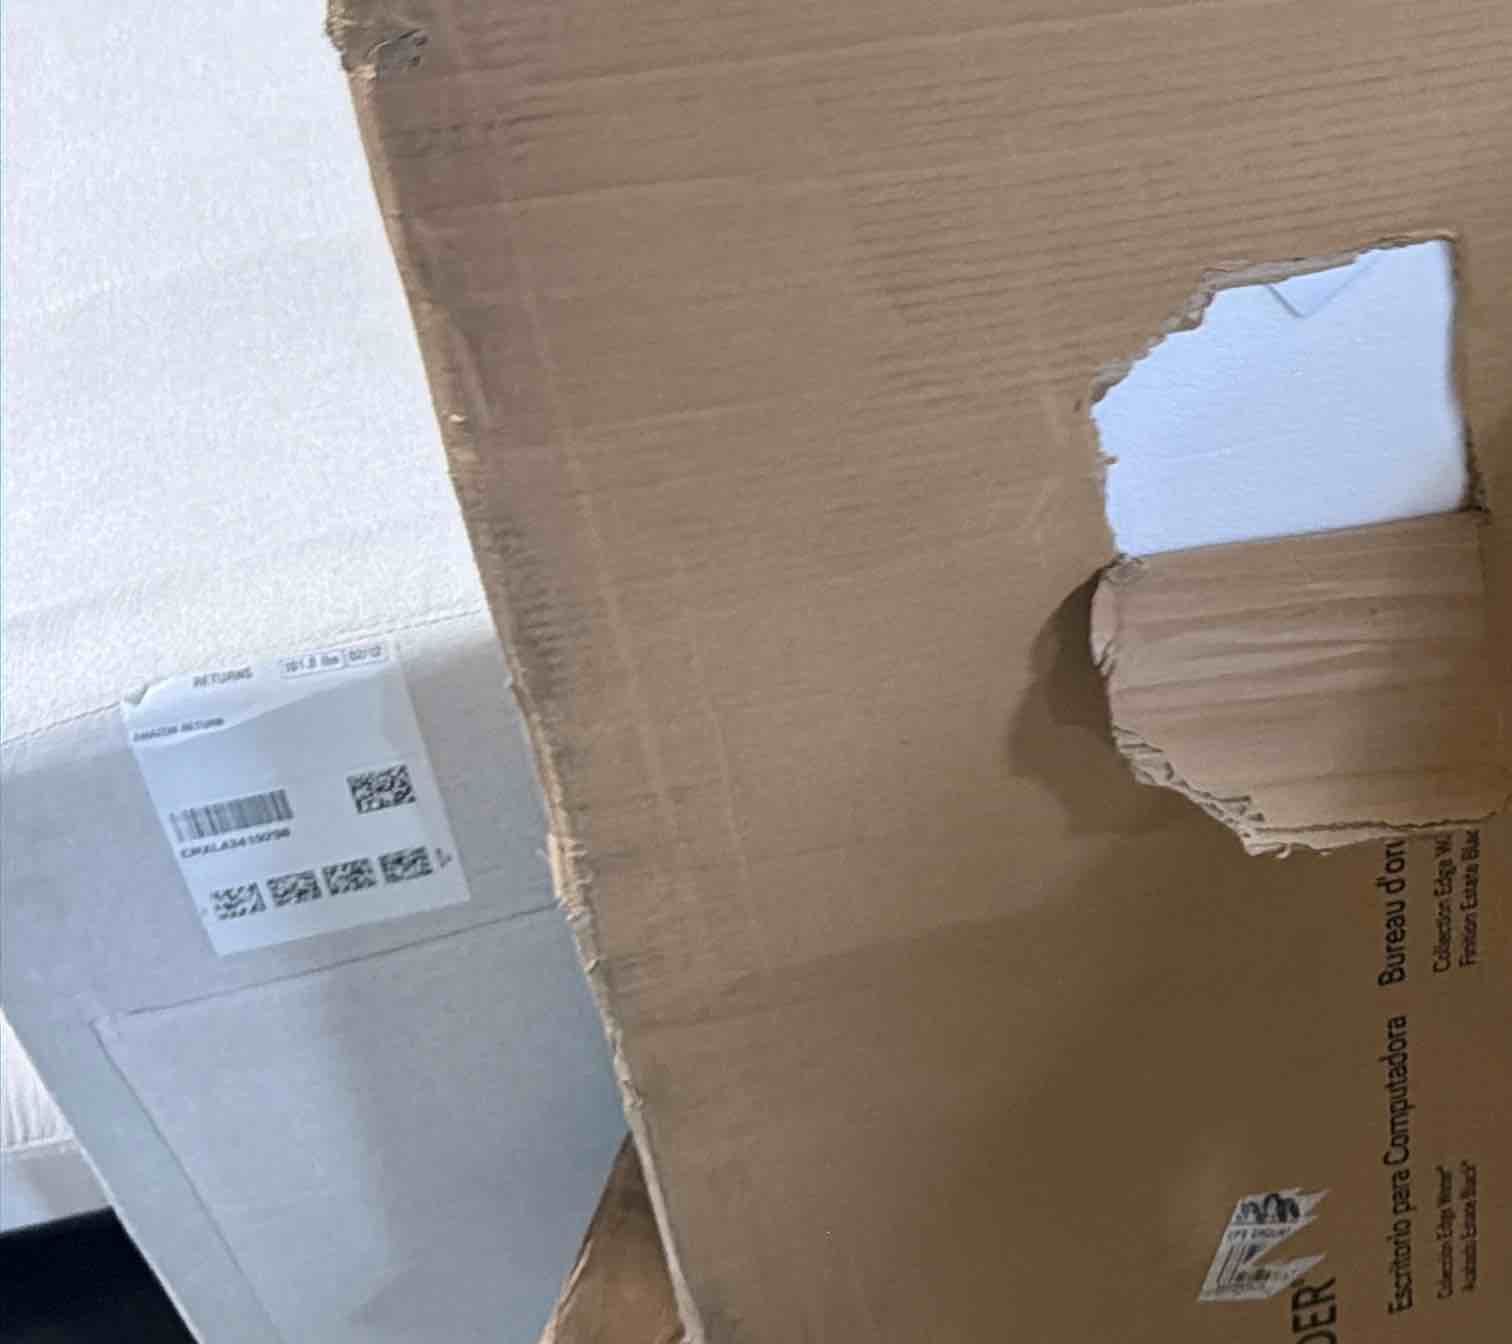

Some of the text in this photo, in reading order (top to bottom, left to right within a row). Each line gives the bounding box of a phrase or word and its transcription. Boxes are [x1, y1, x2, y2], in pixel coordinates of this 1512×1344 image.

[1377, 901, 1406, 986] Bureau
[1378, 1016, 1416, 1314] Escritorio para Computadora
